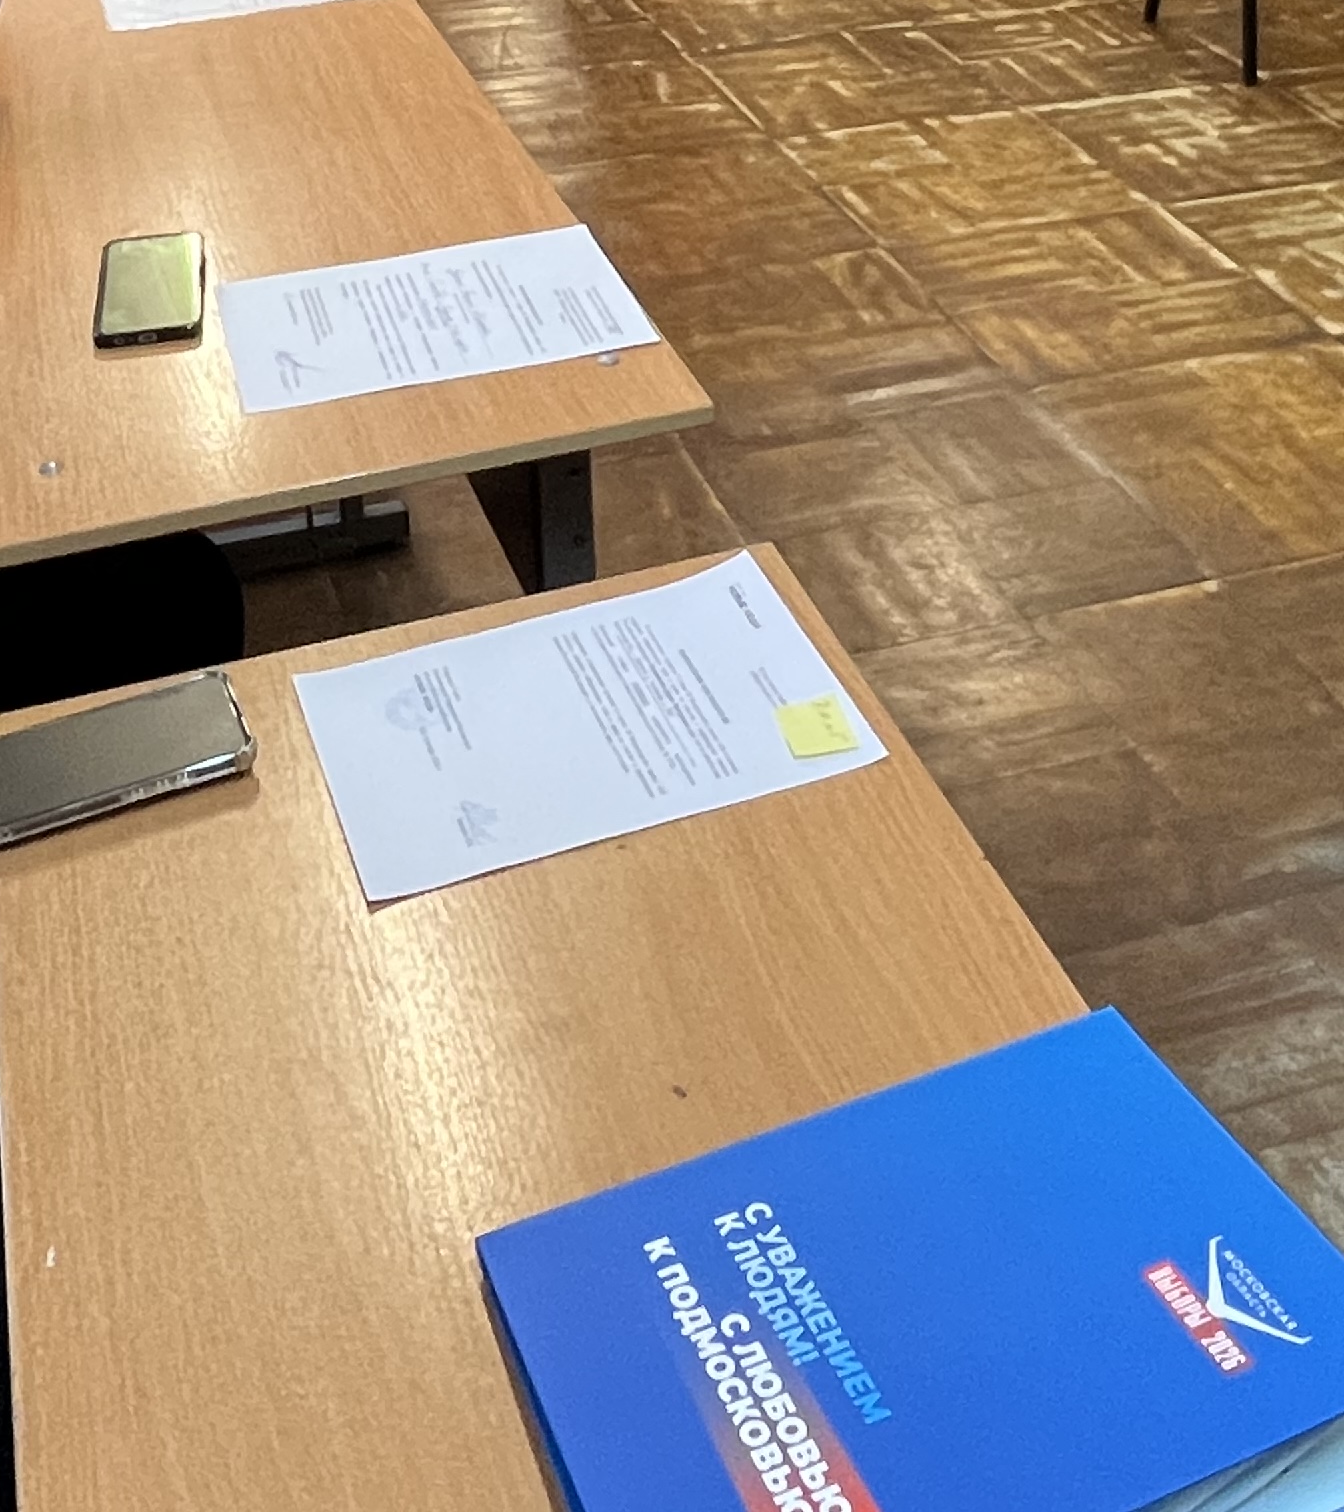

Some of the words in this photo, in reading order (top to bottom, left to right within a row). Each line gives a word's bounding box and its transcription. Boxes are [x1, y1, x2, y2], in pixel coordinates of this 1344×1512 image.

[713, 1211, 746, 1237] К
[744, 1202, 773, 1226] С
[642, 1236, 676, 1264] К
[726, 1238, 820, 1367] ЛЮДЯМ!
[1223, 1250, 1298, 1330] МОСКОВСКАЯ
[720, 1312, 751, 1338] С
[755, 1224, 892, 1425] УВАЖЕНИЕМ
